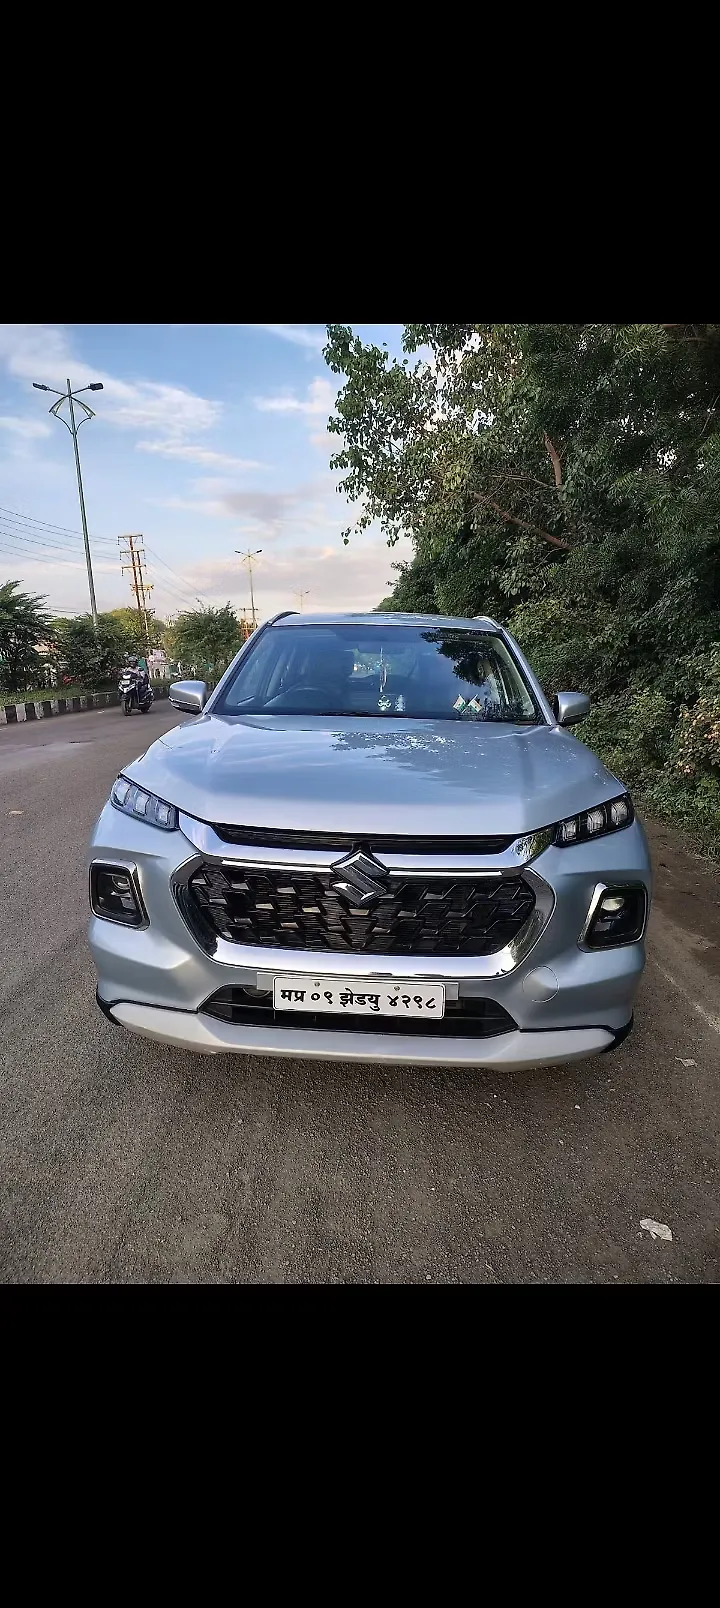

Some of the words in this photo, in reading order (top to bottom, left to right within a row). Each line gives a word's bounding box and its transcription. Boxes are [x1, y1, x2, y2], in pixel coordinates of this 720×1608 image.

[280, 989, 307, 1003] मप्र
[310, 990, 334, 1005] ०९
[338, 987, 381, 1012] झेडयु
[386, 994, 437, 1010] ४२९८
